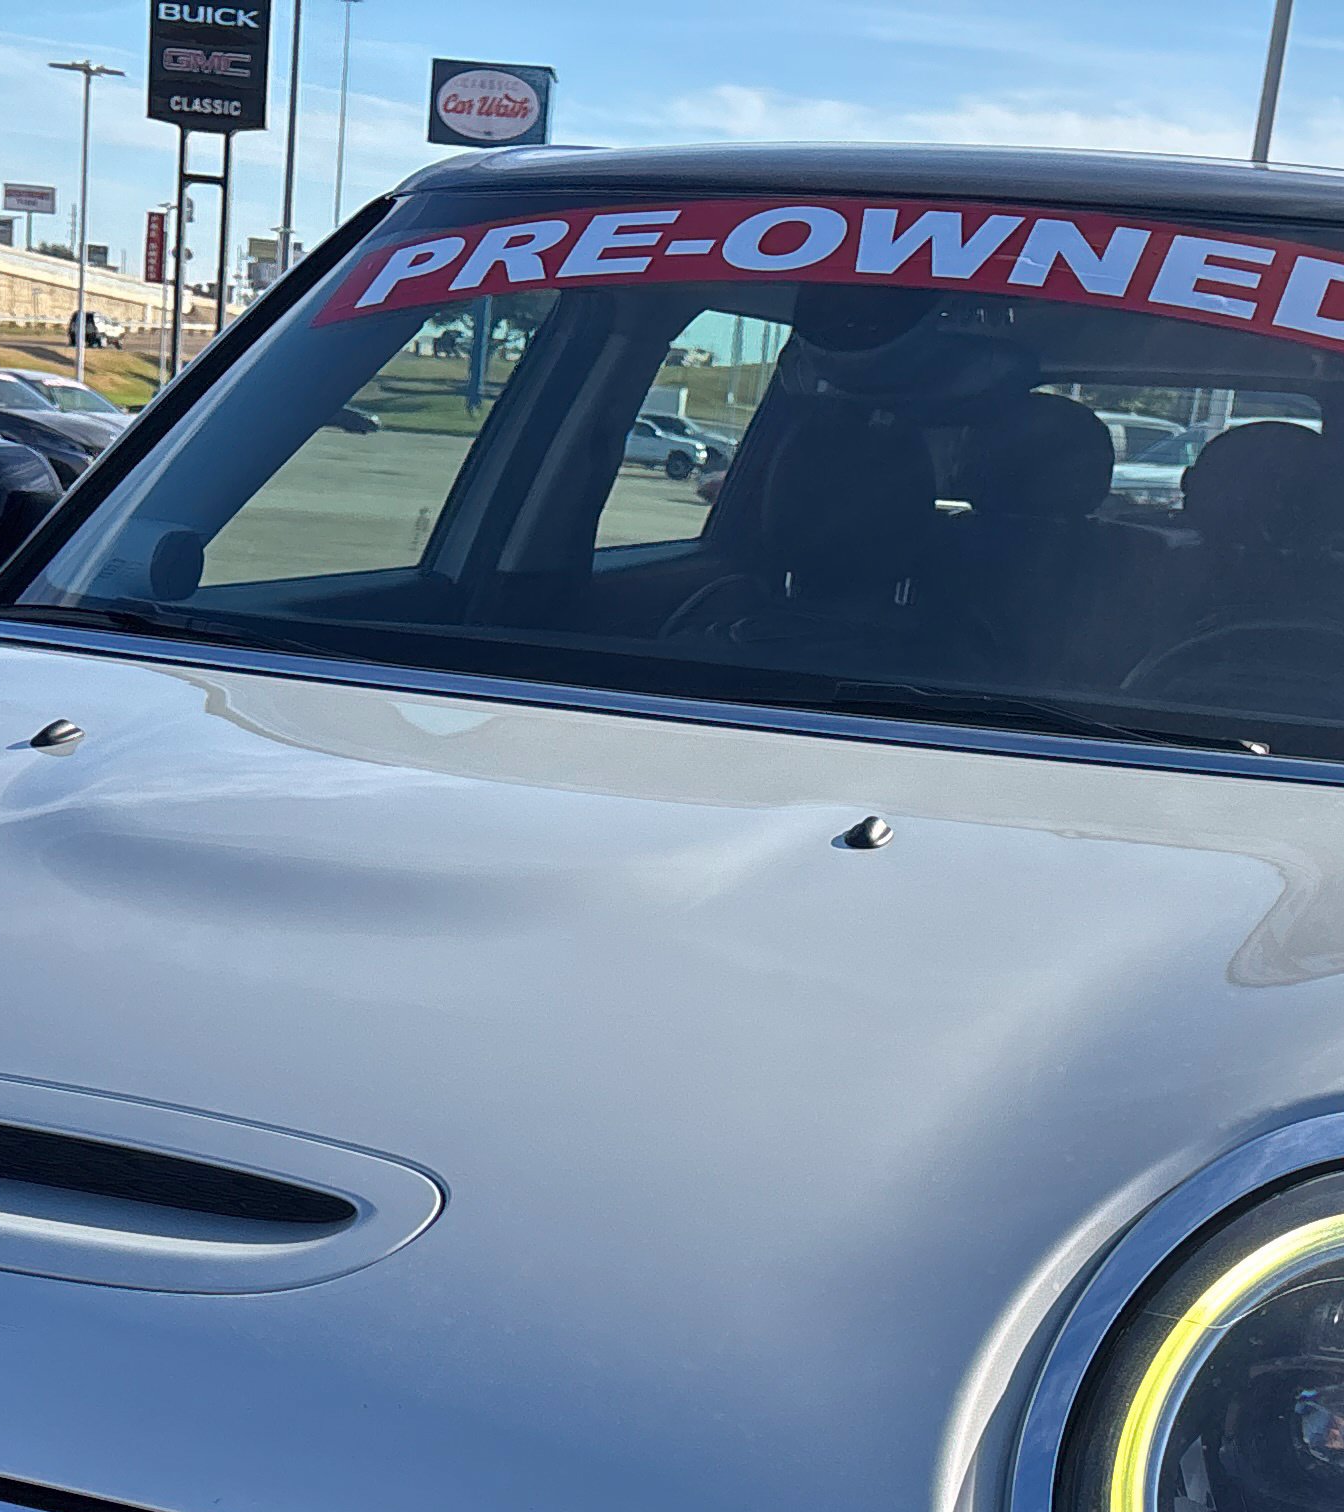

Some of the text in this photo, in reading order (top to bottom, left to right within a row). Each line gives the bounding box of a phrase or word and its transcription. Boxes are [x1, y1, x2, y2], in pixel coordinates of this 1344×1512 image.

[157, 3, 259, 28] BUICK
[163, 47, 251, 78] GMC
[169, 95, 241, 116] CLASSIC
[443, 92, 531, 118] Car Wash
